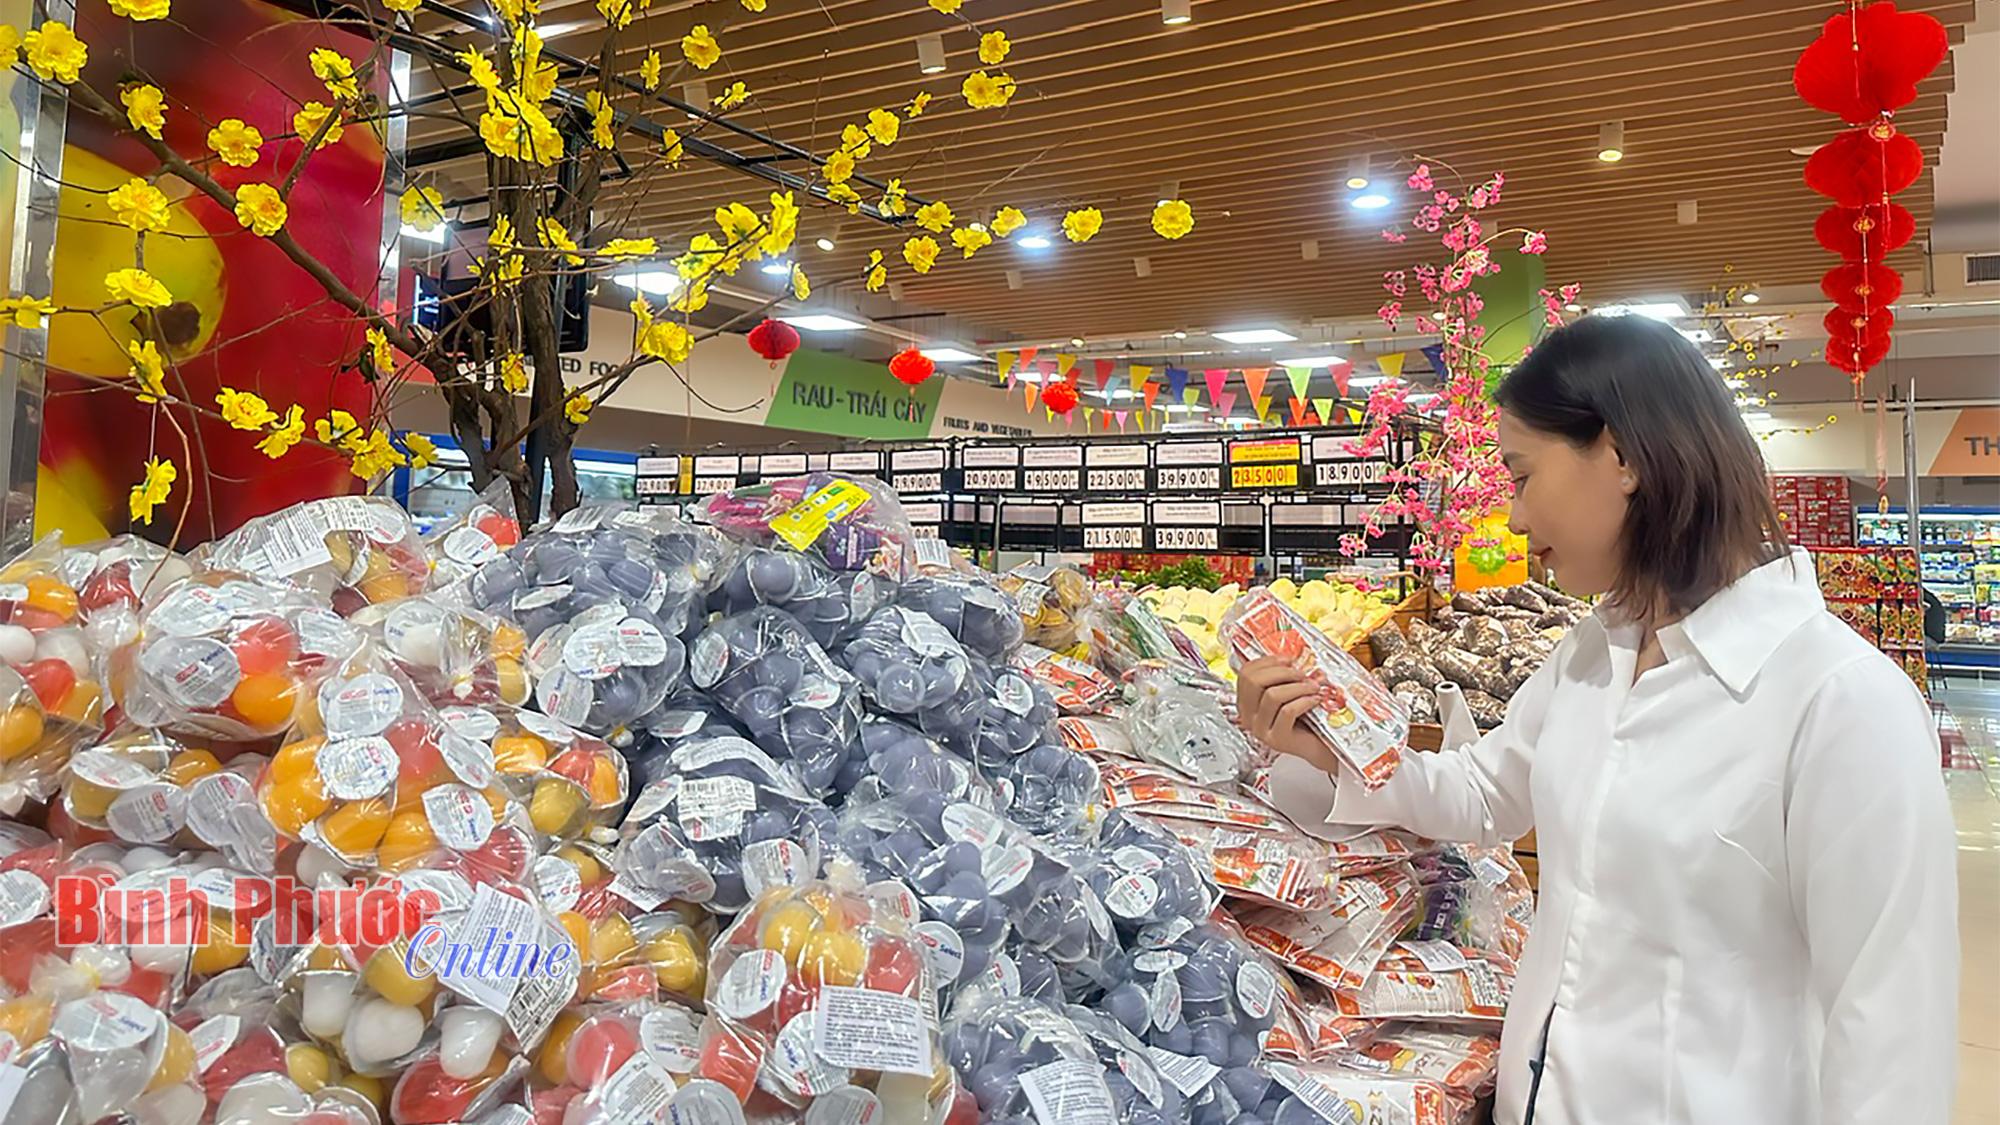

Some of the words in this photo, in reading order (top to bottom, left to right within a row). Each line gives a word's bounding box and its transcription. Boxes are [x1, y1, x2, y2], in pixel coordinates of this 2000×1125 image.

[973, 421, 989, 433] AND
[966, 472, 1007, 487] 20.900
[1026, 473, 1069, 488] 49.500
[1089, 472, 1135, 487] 22.500
[1159, 471, 1208, 486] 39.900
[1233, 467, 1284, 484] 23.500
[1318, 464, 1373, 482] 18.900
[1086, 529, 1131, 545] 21.500
[1156, 530, 1205, 546] 39.900
